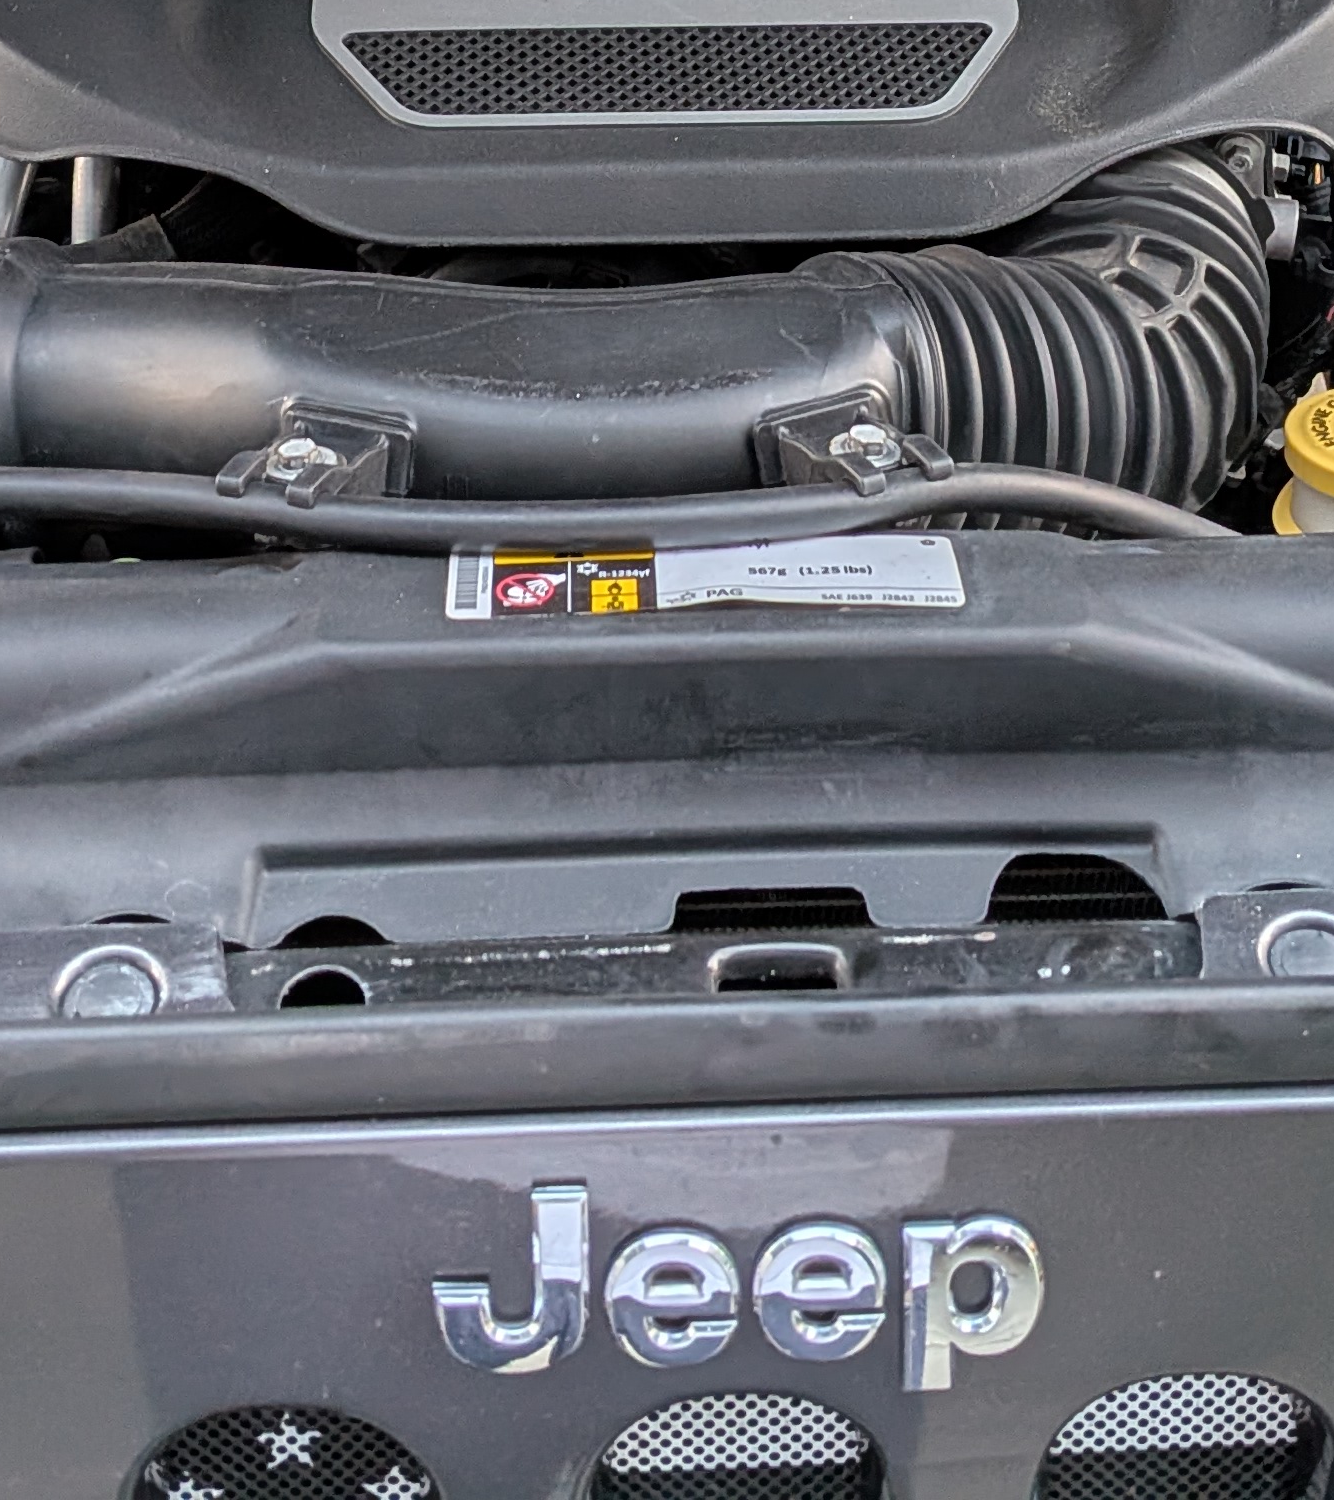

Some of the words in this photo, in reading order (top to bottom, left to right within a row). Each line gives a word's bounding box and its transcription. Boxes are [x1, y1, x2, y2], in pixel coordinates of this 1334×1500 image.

[748, 564, 788, 577] 567g
[843, 564, 873, 576] lbs)
[706, 587, 744, 598] PAG
[433, 1178, 1045, 1392] Jeep
